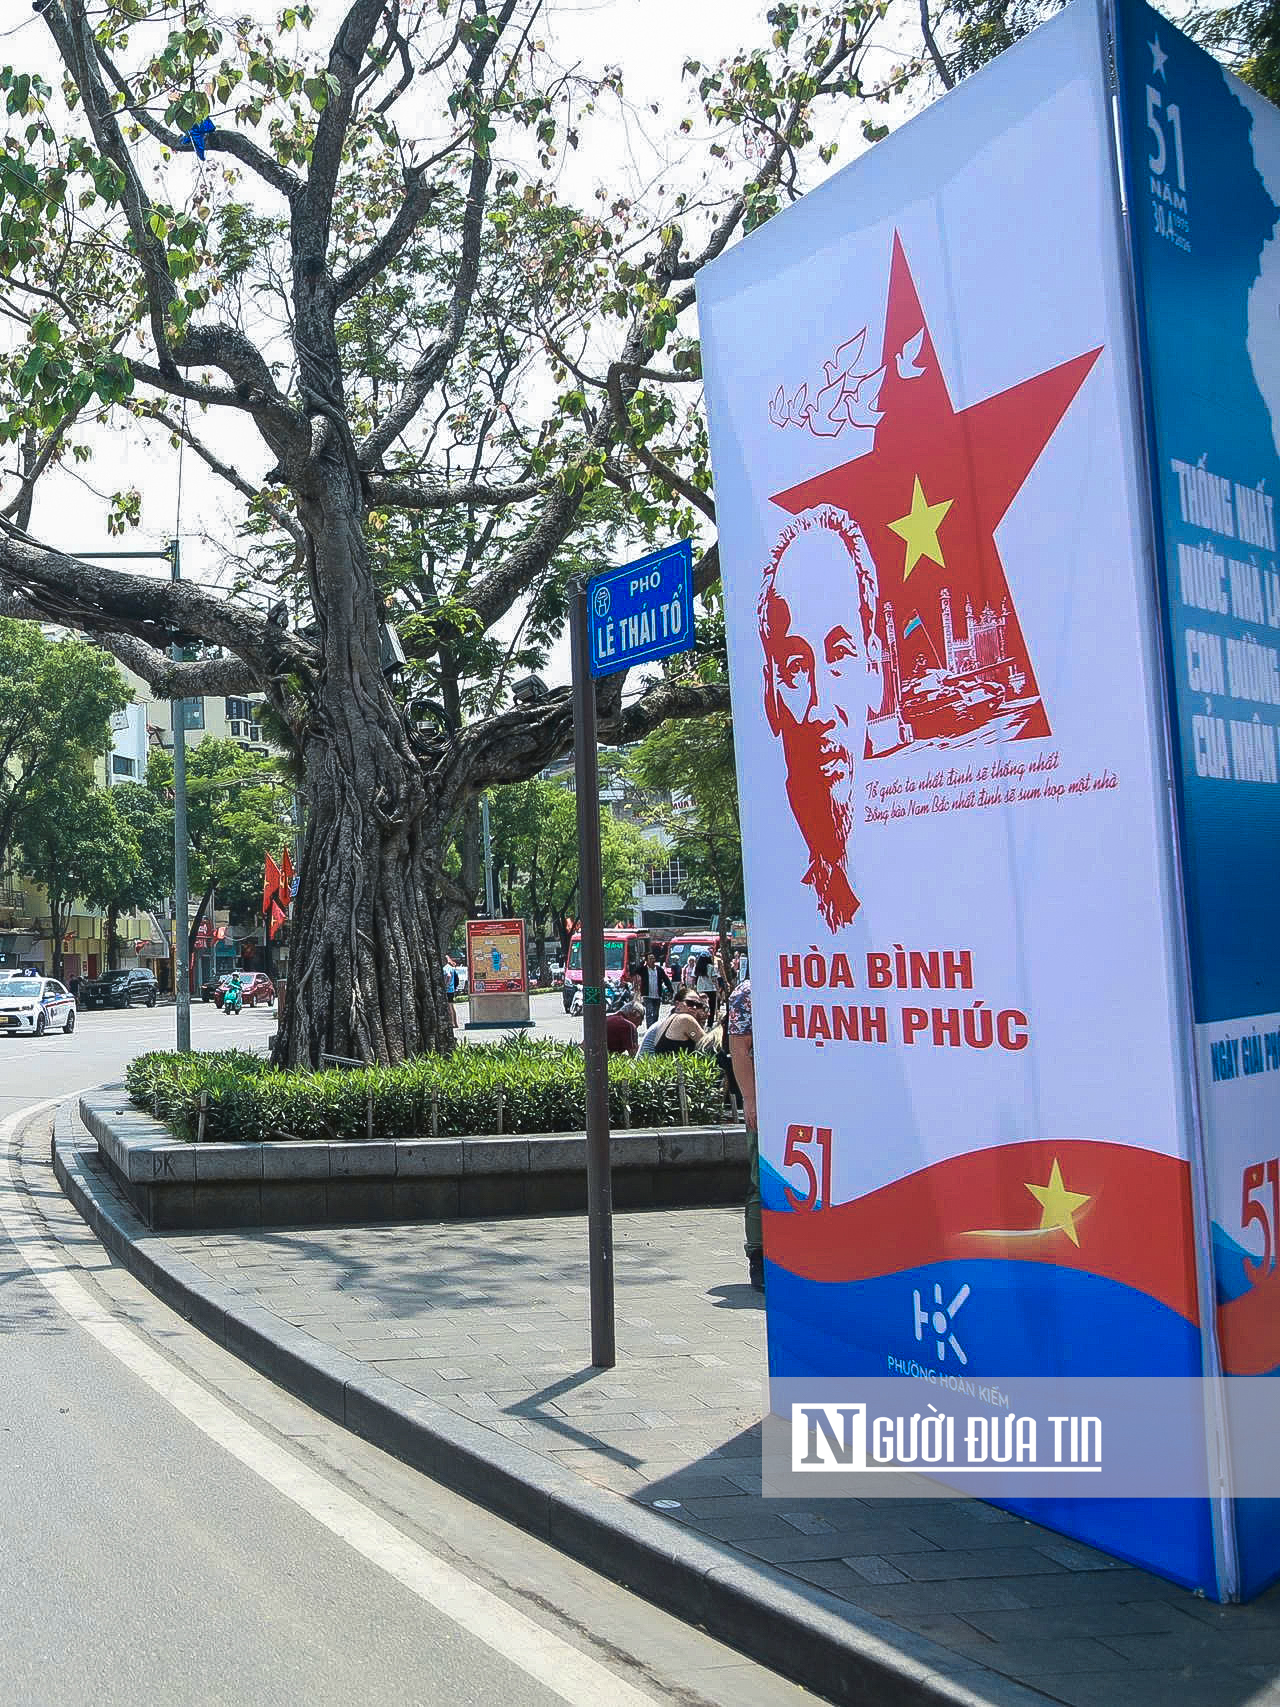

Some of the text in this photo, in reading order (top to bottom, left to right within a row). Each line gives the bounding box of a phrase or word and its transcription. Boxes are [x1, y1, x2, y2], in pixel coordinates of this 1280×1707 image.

[1145, 84, 1187, 192] 51
[629, 562, 661, 597] PHỐ
[597, 583, 683, 659] LÊ THÁI TỔ
[1185, 628, 1225, 696] CON
[1191, 696, 1233, 780] CỦA
[778, 943, 974, 990] HÒA BÌNH
[782, 1000, 1030, 1051] HẠNH PHÚC
[783, 1124, 833, 1213] 51
[1241, 1157, 1280, 1284] 51
[887, 1353, 937, 1386] PHƯỜNG
[939, 1371, 976, 1398] HOÀN
